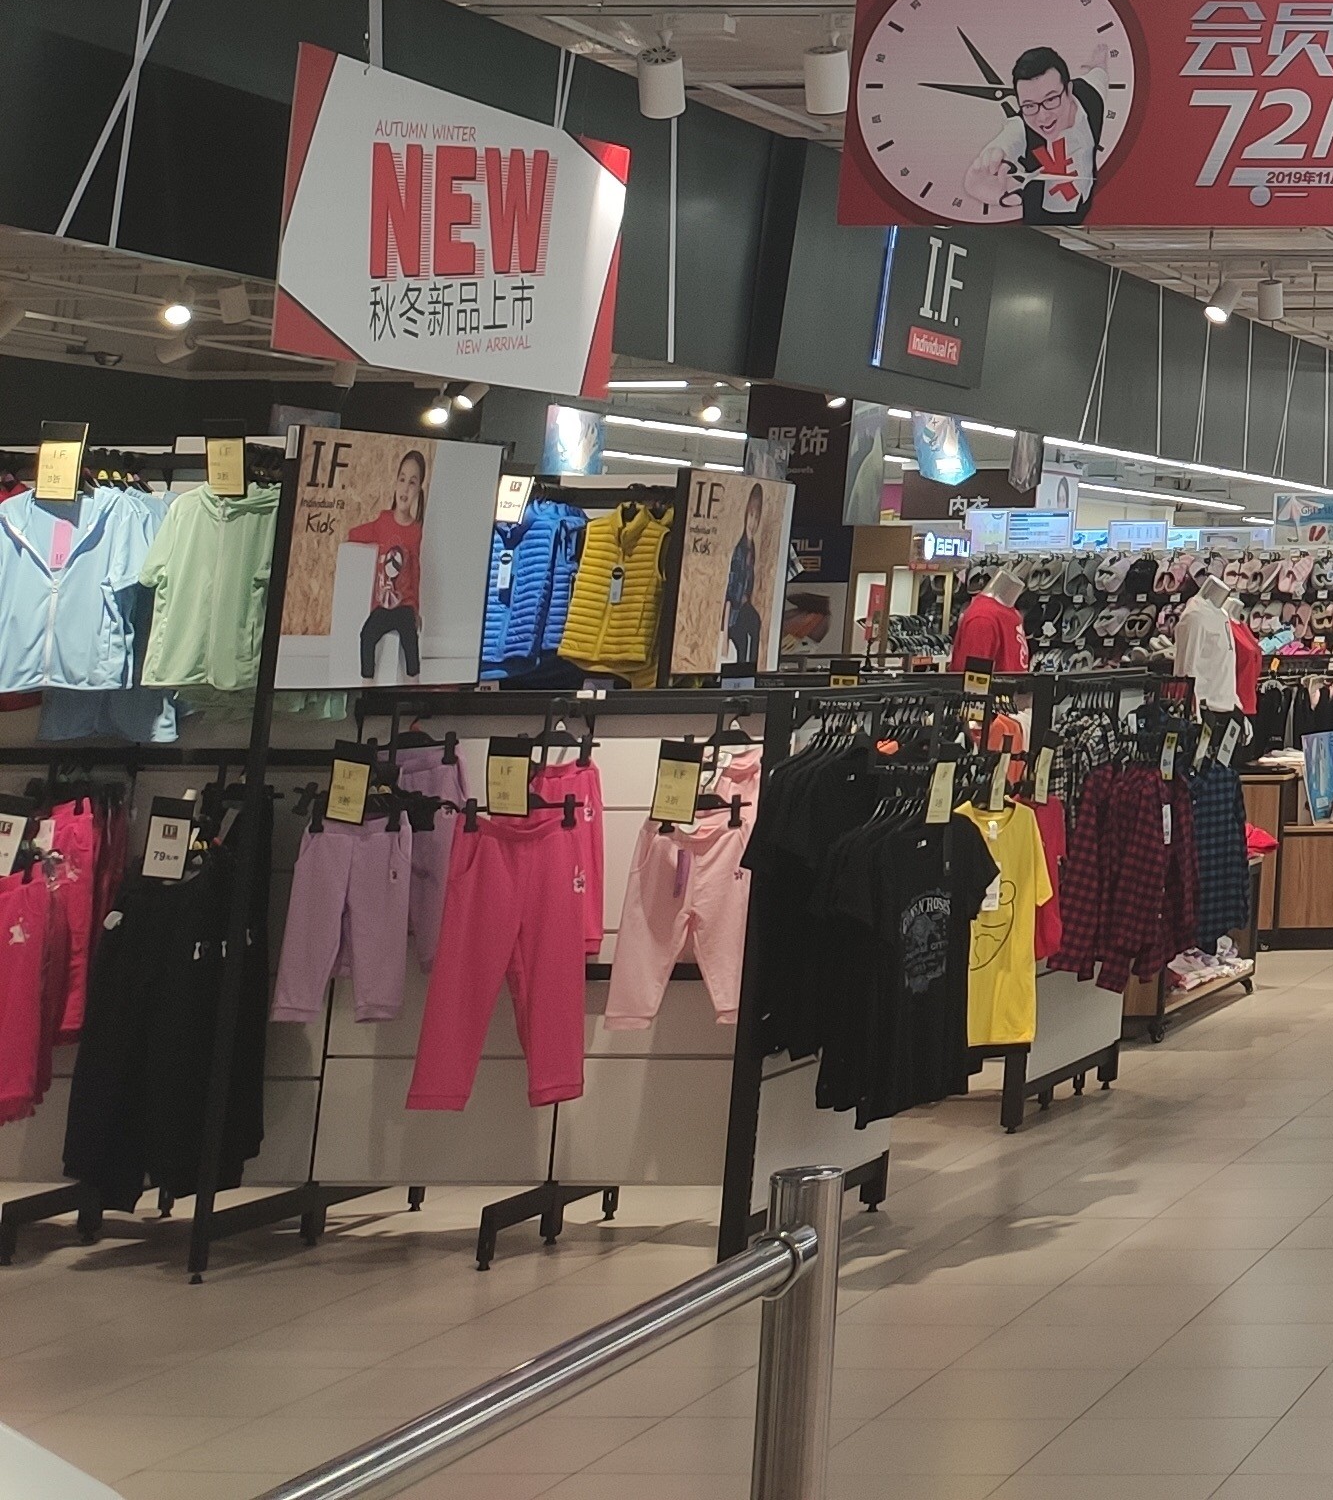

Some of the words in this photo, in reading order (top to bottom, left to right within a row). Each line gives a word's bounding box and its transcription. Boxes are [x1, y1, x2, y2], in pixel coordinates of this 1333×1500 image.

[375, 119, 427, 138] AUTUMN
[433, 124, 476, 141] WINTER
[370, 142, 558, 281] NEW
[369, 278, 535, 341] 秋冬新品上市
[456, 340, 481, 355] NEW
[486, 336, 532, 352] ARRIVAL
[912, 332, 949, 358] Individual
[948, 340, 960, 362] Fit
[301, 496, 337, 509] Individual
[336, 499, 346, 510] Fit
[305, 512, 335, 536] Kids
[691, 537, 712, 554] Kids
